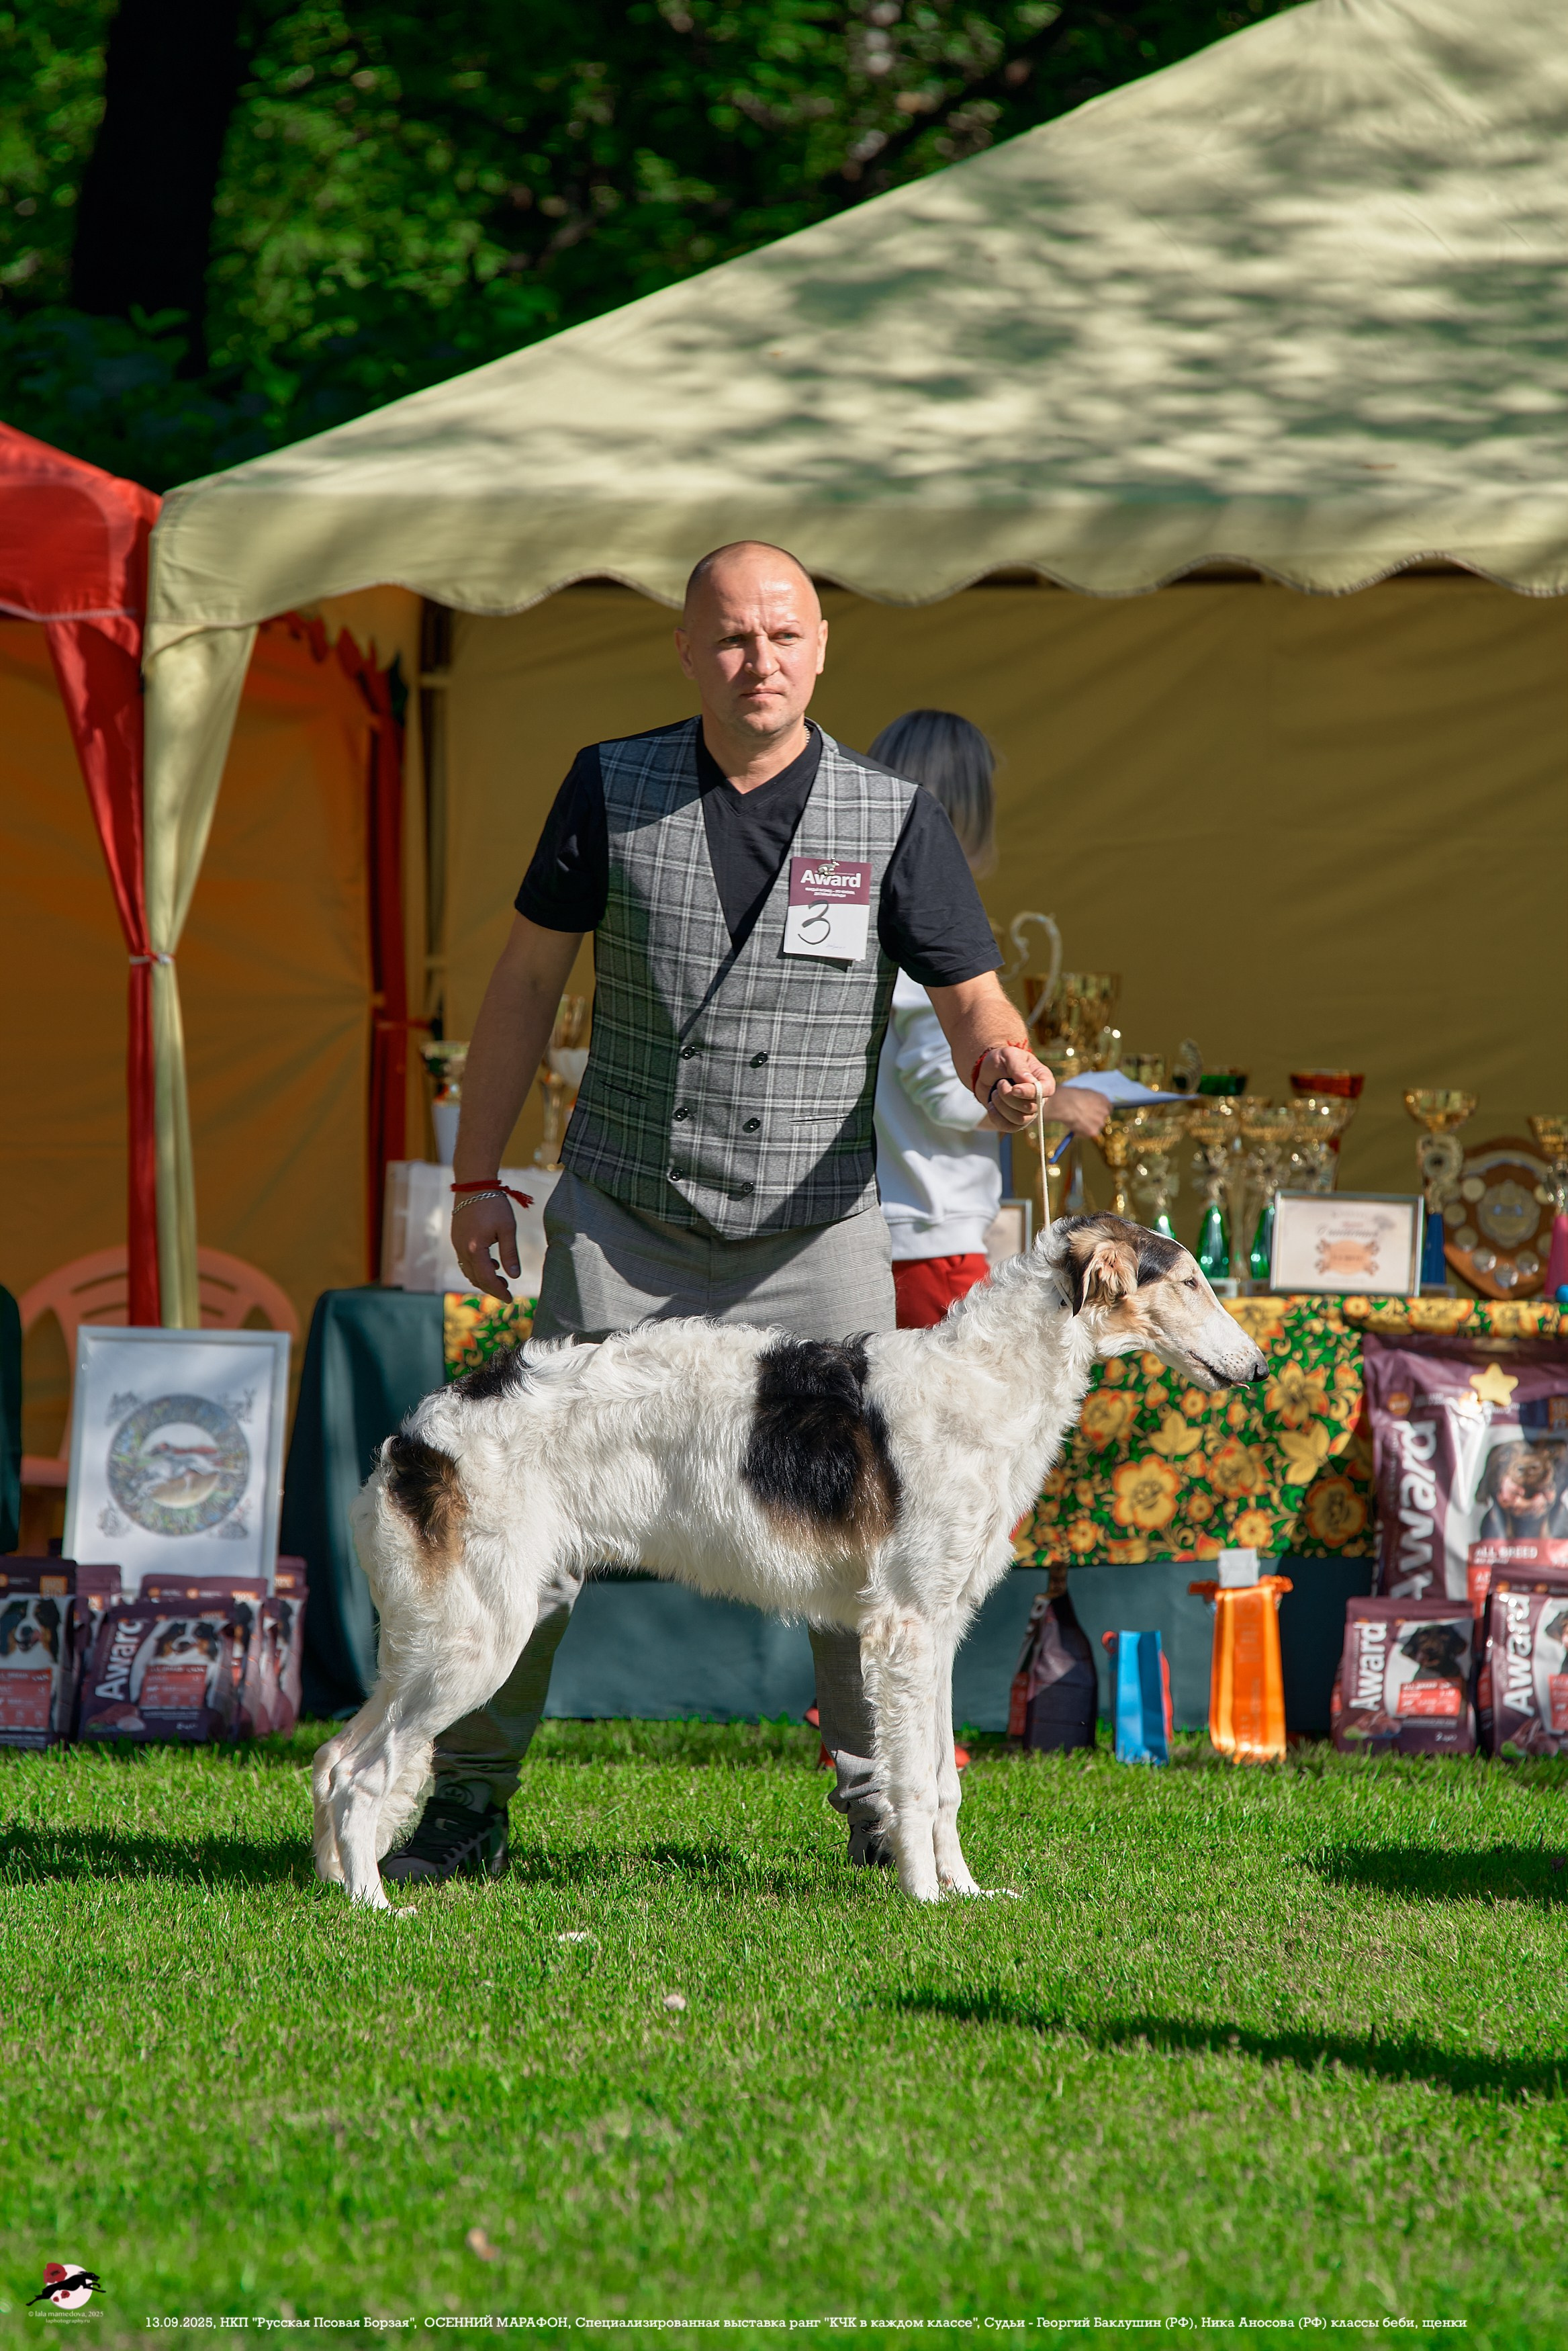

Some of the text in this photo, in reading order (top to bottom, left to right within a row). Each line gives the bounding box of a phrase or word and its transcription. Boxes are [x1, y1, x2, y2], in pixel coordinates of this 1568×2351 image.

[800, 869, 862, 888] Award
[798, 899, 831, 945] 3
[1349, 1622, 1387, 1712] Award
[1498, 1592, 1535, 1718] Award
